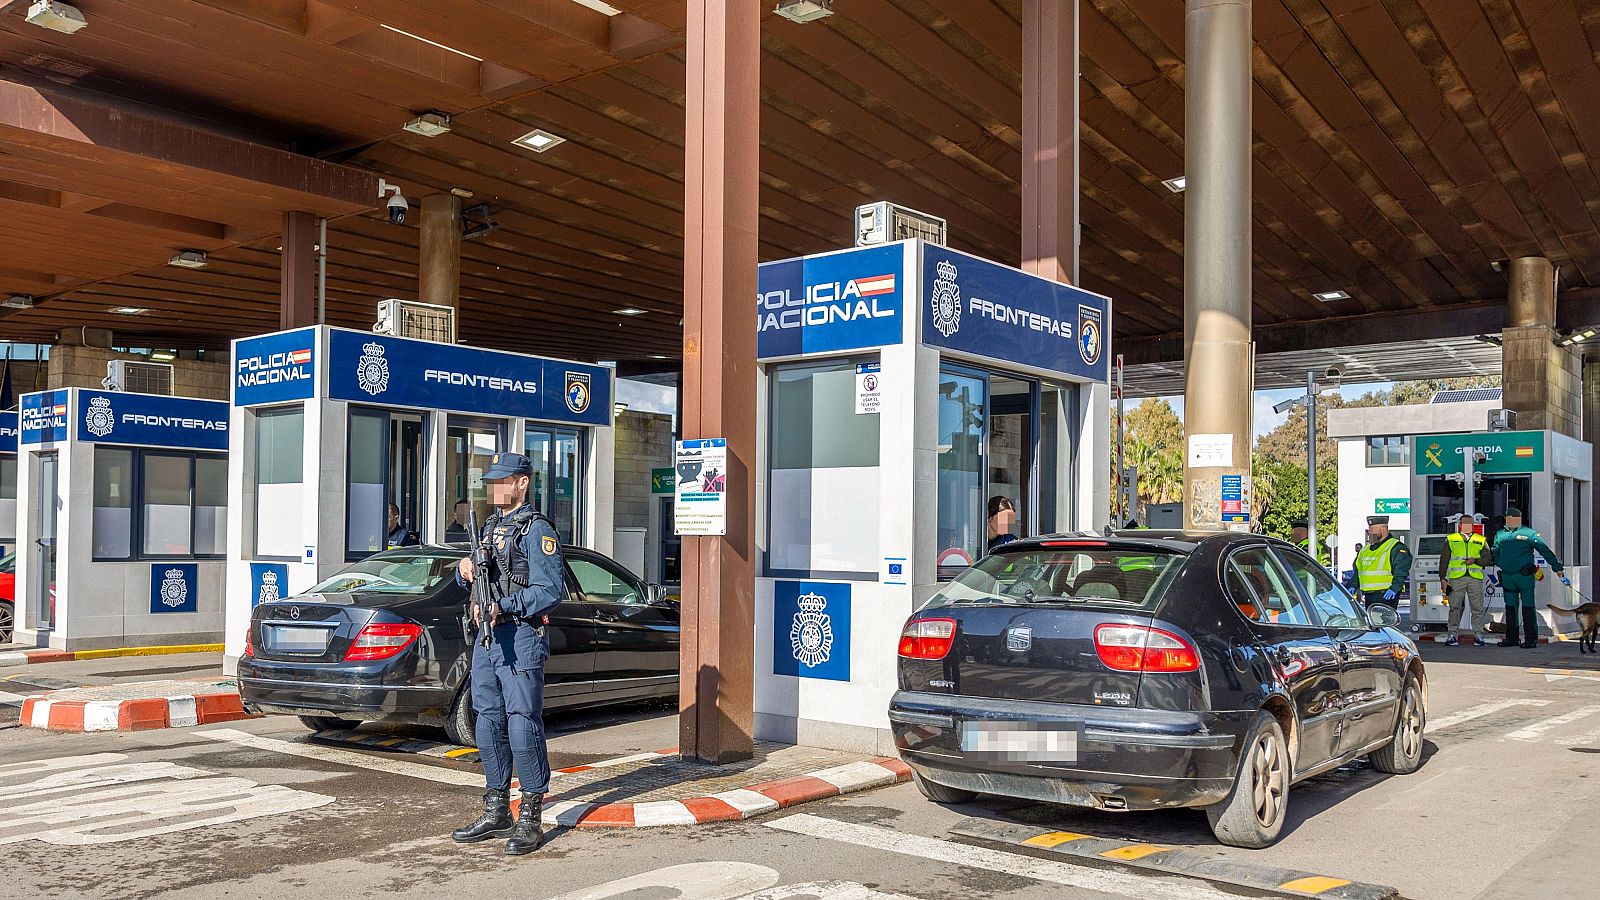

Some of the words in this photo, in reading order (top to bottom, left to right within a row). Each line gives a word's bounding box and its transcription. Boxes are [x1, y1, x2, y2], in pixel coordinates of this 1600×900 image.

[969, 297, 1073, 339] FRONTERAS
[238, 366, 311, 388] NACIONAL
[424, 369, 537, 393] FRONTERAS
[22, 416, 66, 431] NACIONAL
[122, 413, 227, 431] FRONTERAS
[929, 680, 955, 689] SEAT
